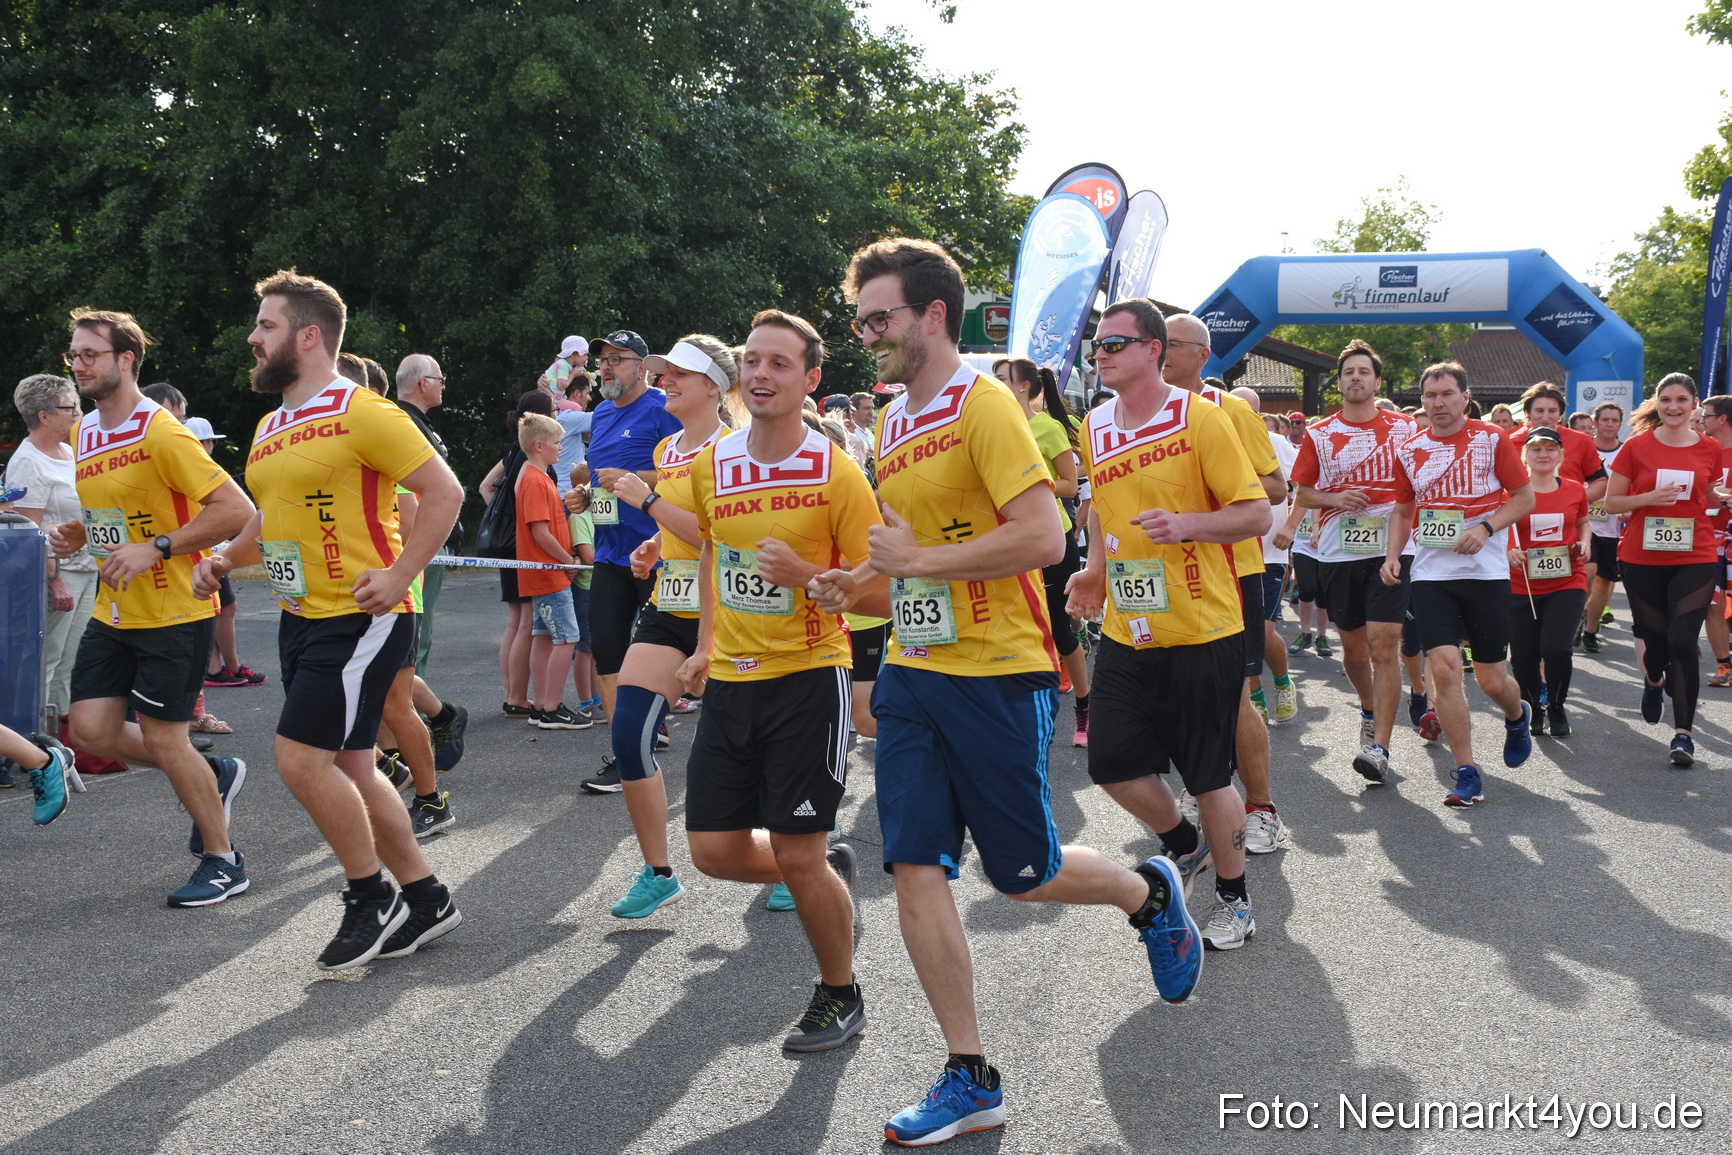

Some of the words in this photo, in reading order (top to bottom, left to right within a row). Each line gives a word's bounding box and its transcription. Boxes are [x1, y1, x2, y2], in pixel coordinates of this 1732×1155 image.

[1125, 210, 1152, 287] Fischer
[1365, 287, 1450, 304] firmenlauf
[1206, 318, 1250, 327] Fischer
[247, 438, 285, 467] MAX
[289, 421, 350, 446] BÖGL
[75, 461, 104, 483] MAX
[108, 447, 151, 471] BÖGL
[877, 452, 908, 485] MAX
[913, 430, 962, 464] BÖGL
[1093, 458, 1135, 489] MAX
[1138, 438, 1192, 469] BÖGL
[714, 498, 763, 520] MAX
[770, 491, 830, 511] BÖGL
[87, 526, 120, 545] 1630
[1344, 529, 1378, 543] 2221
[1422, 522, 1456, 537] 2205
[1654, 529, 1682, 542] 503
[266, 560, 295, 581] 595
[477, 559, 538, 570] Raiffeisenbank
[1537, 557, 1562, 570] 480
[660, 578, 695, 597] 1707
[1115, 578, 1155, 598] 1651
[731, 594, 745, 602] Merz
[746, 597, 772, 605] Thomas
[895, 599, 942, 626] 1653
